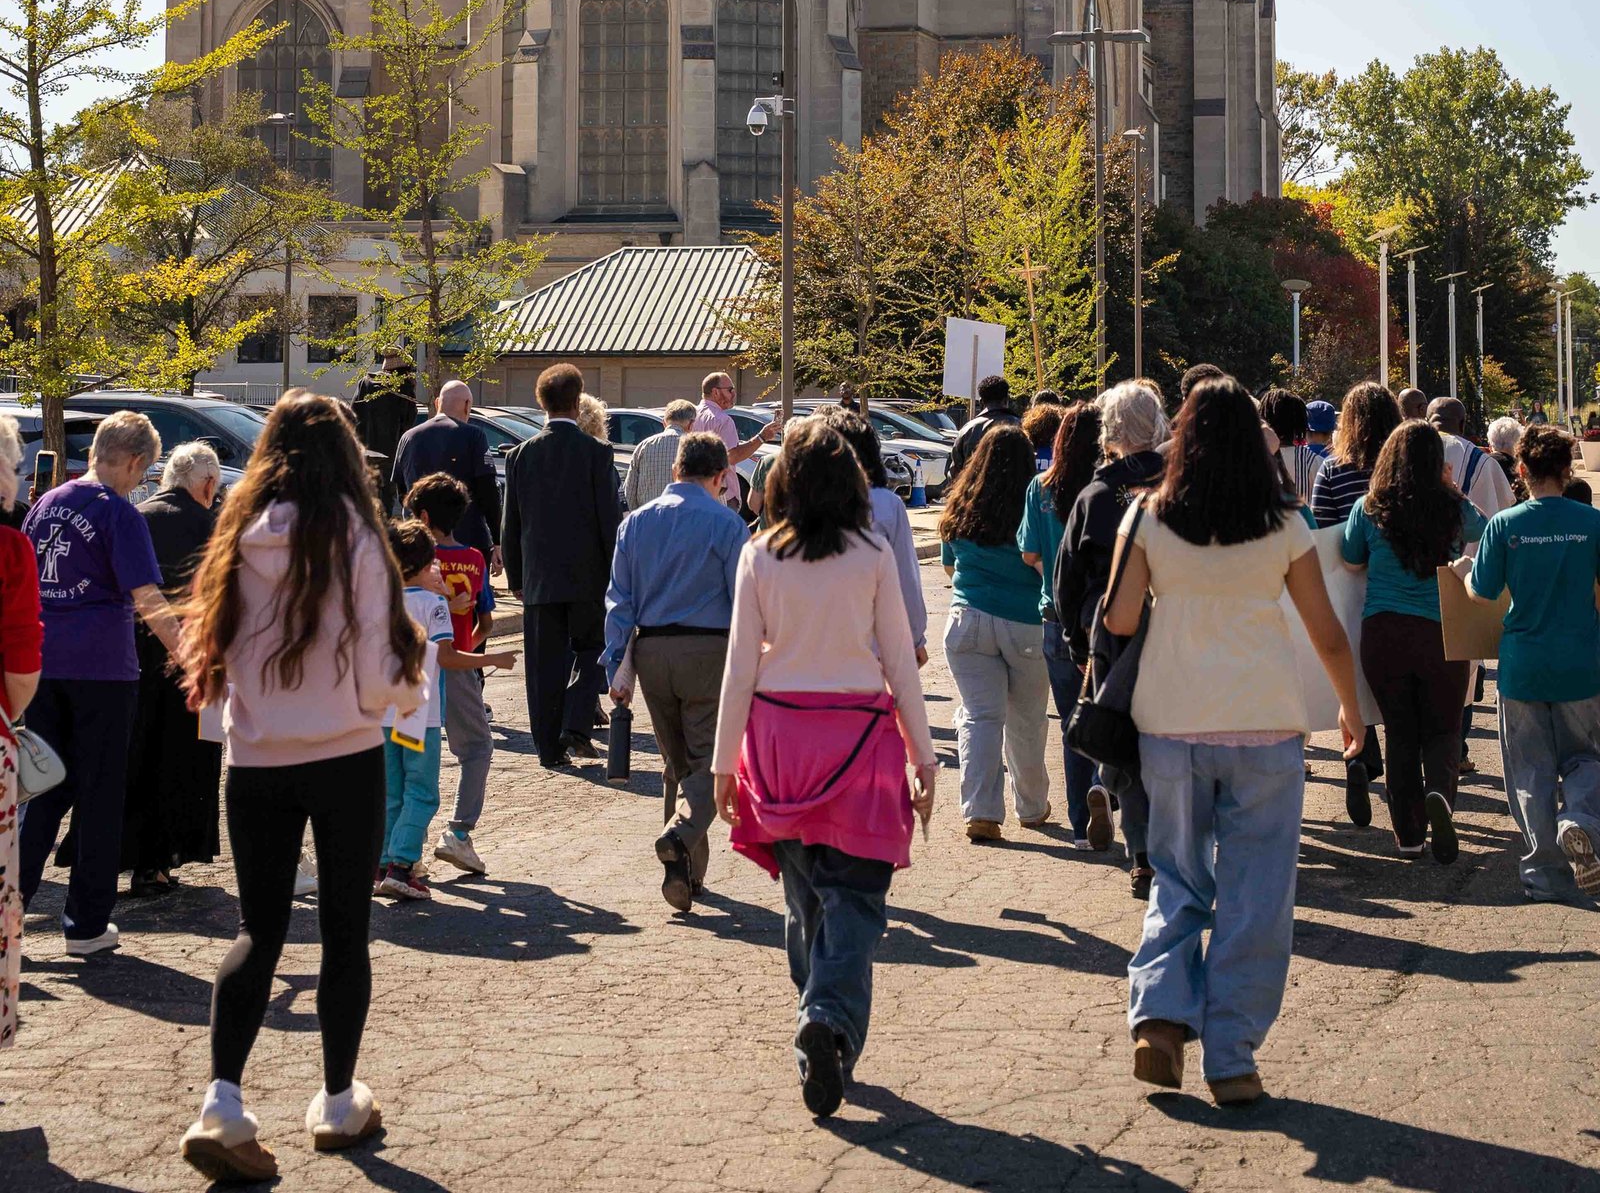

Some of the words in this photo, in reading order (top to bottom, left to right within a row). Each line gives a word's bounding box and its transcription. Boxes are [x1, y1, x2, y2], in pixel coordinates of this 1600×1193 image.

[1520, 535, 1553, 544] Strangers
[1554, 534, 1564, 542] No
[1565, 533, 1588, 543] Longer
[69, 587, 75, 599] y
